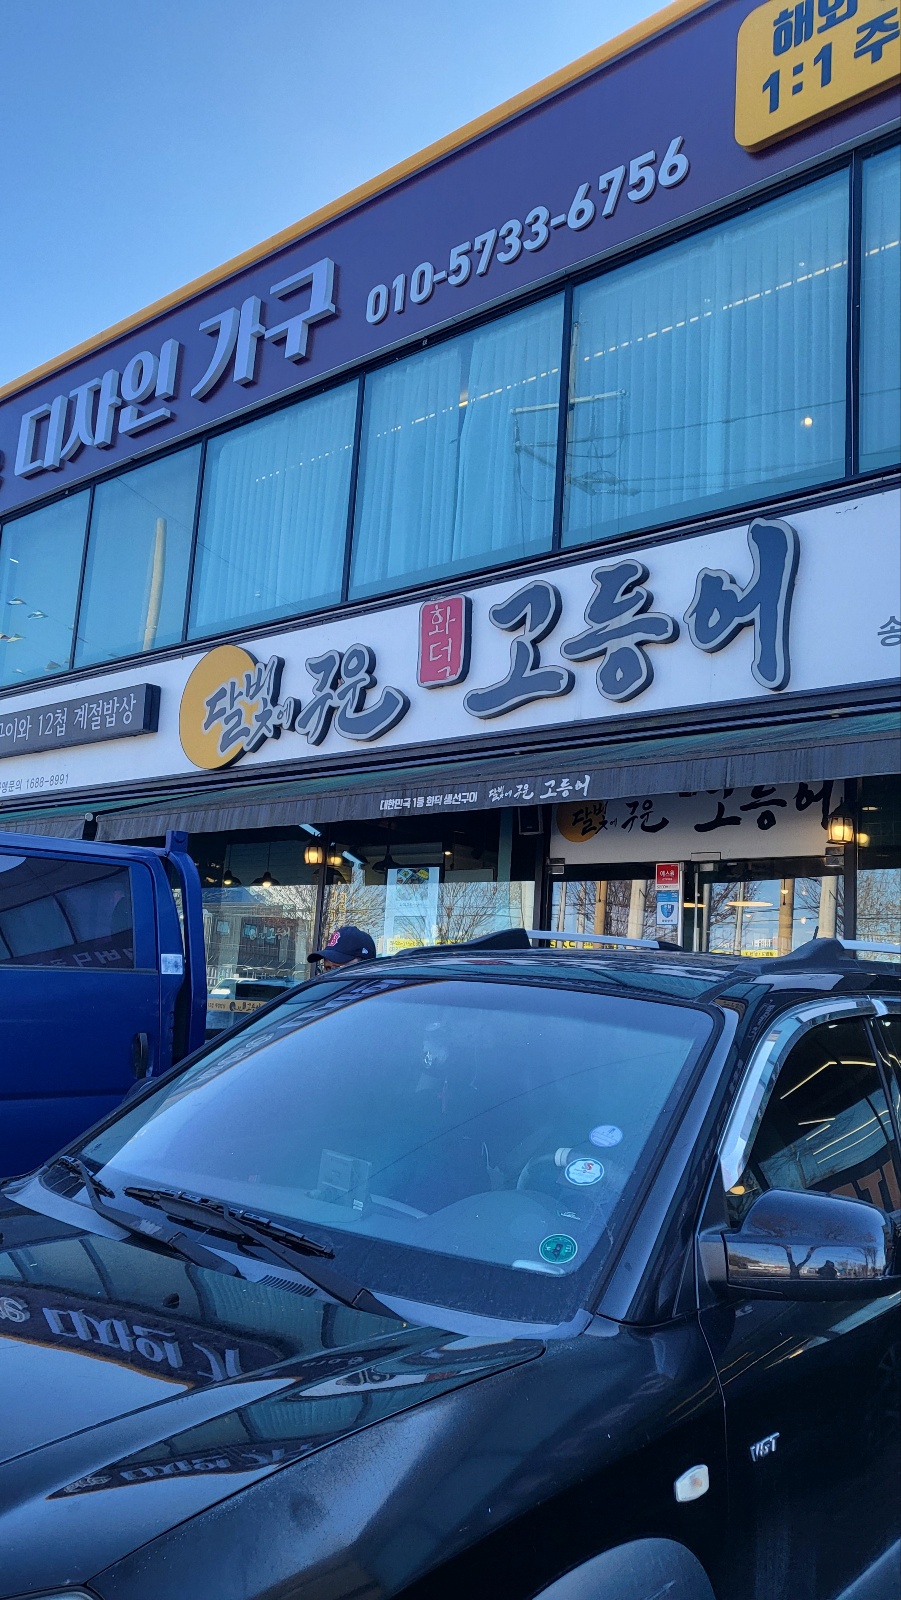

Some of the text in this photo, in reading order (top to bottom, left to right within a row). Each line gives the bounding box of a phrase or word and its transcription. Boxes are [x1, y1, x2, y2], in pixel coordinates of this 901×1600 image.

[762, 7, 901, 114] 1:1 주
[365, 136, 690, 325] 010-5733-6756
[14, 257, 337, 478] 디자인 가구
[424, 600, 459, 684] 화덕
[463, 517, 799, 719] 고등어
[38, 707, 68, 737] 12첩
[73, 693, 136, 730] 계절밥상
[202, 643, 410, 757] 달빛에 구운
[0, 773, 69, 794] 영문의 1688-8991
[380, 797, 411, 810] 대한민국
[443, 791, 478, 805] 생선구이
[540, 775, 591, 799] 고등어
[621, 799, 670, 833] 구운
